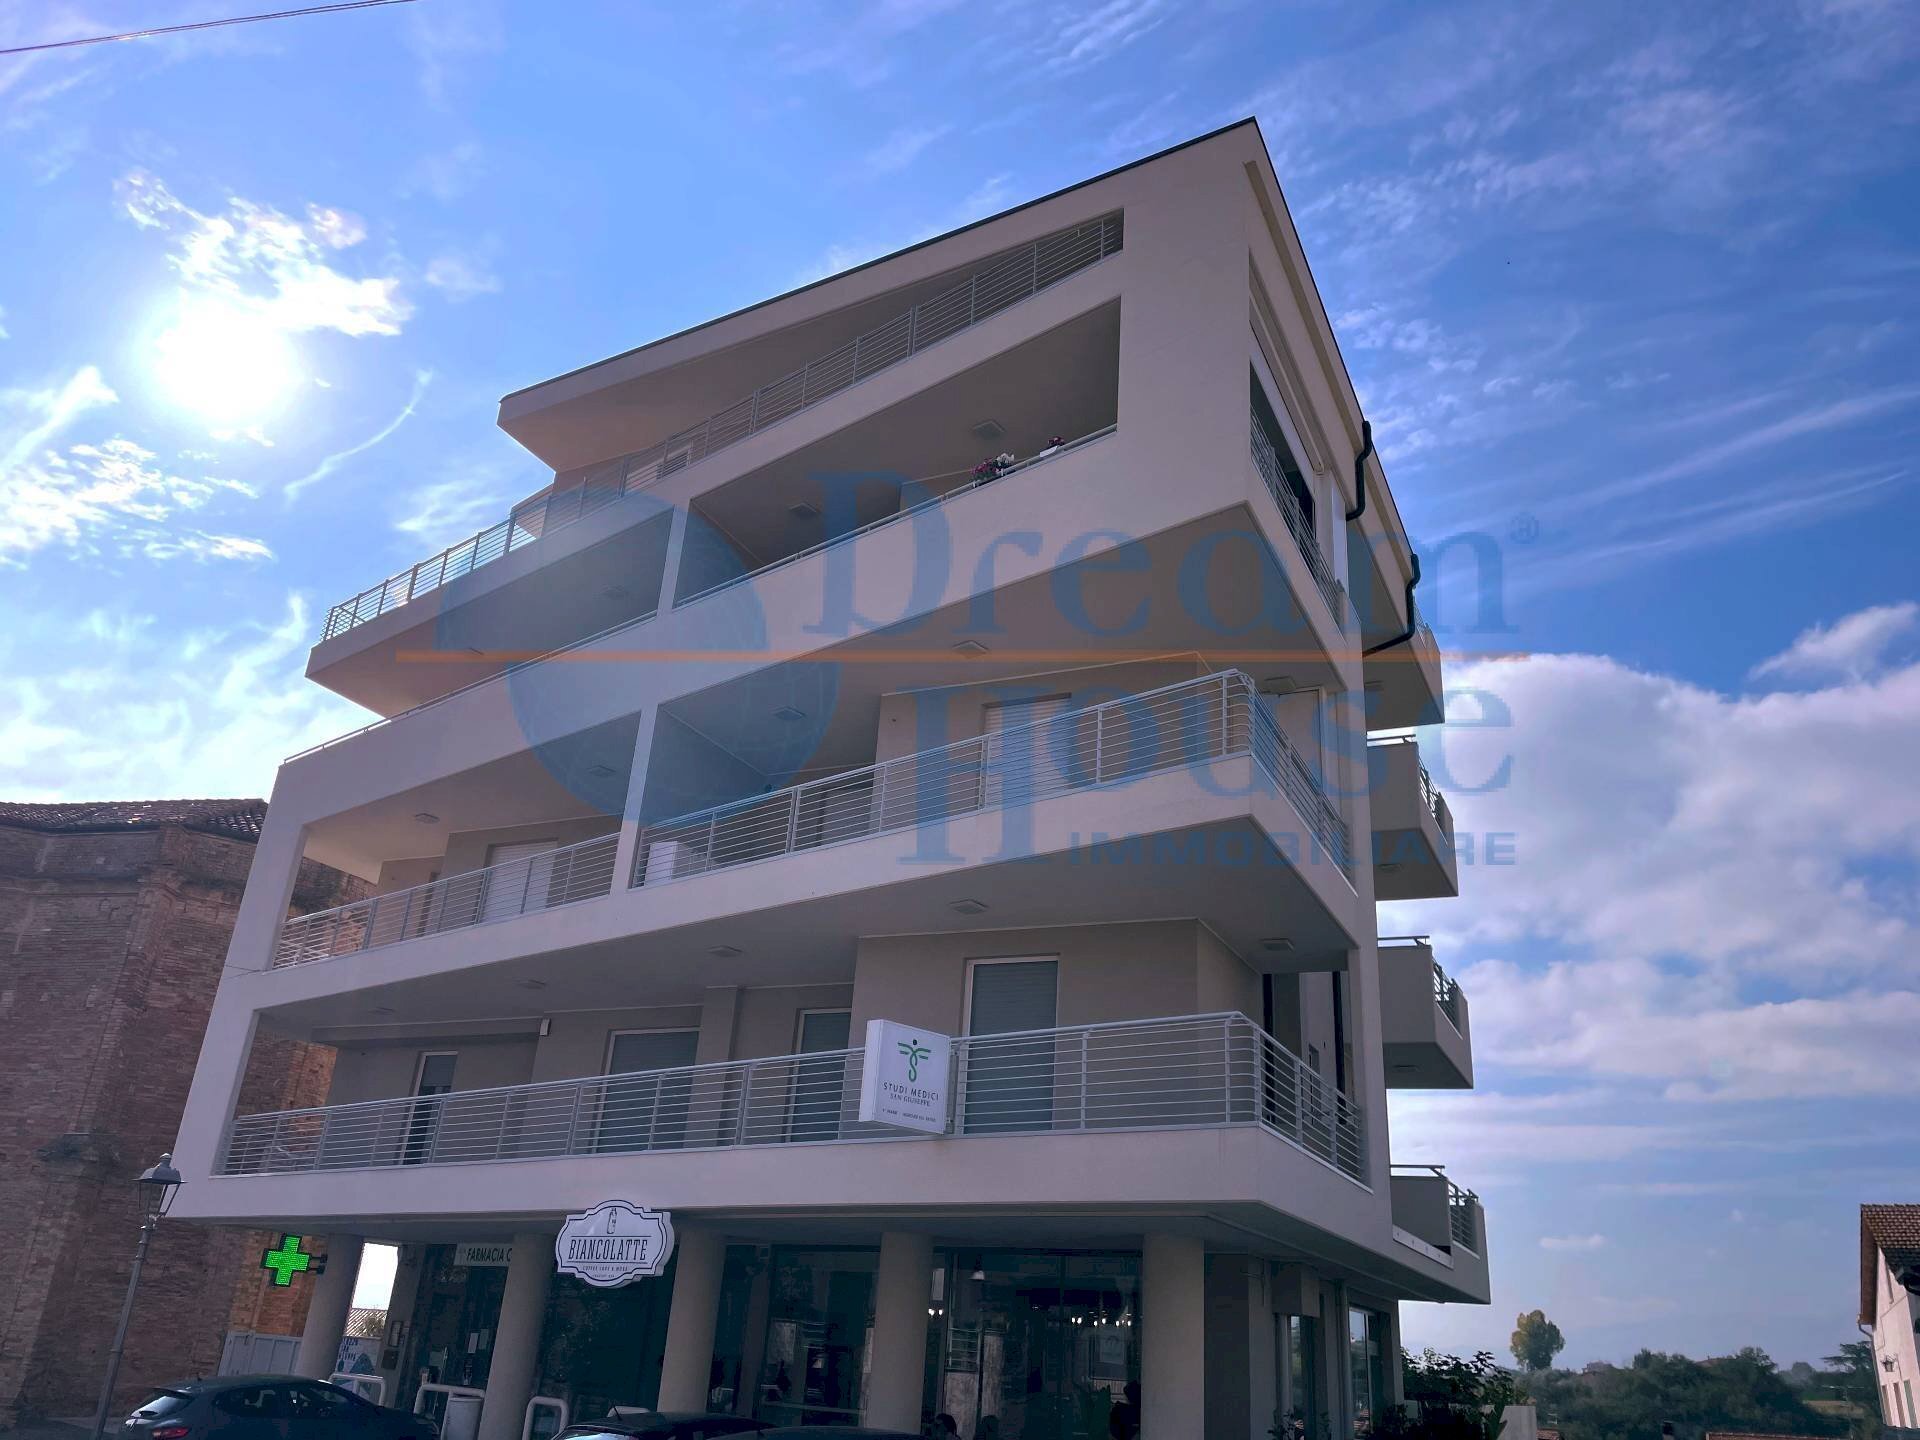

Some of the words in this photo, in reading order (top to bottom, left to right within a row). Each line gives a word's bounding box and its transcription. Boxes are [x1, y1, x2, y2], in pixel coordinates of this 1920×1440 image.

[883, 1082, 907, 1093] STUDI
[911, 1088, 938, 1100] MEDICI
[466, 1247, 504, 1262] FARMACIA
[568, 1239, 648, 1261] BIANCOLATTE
